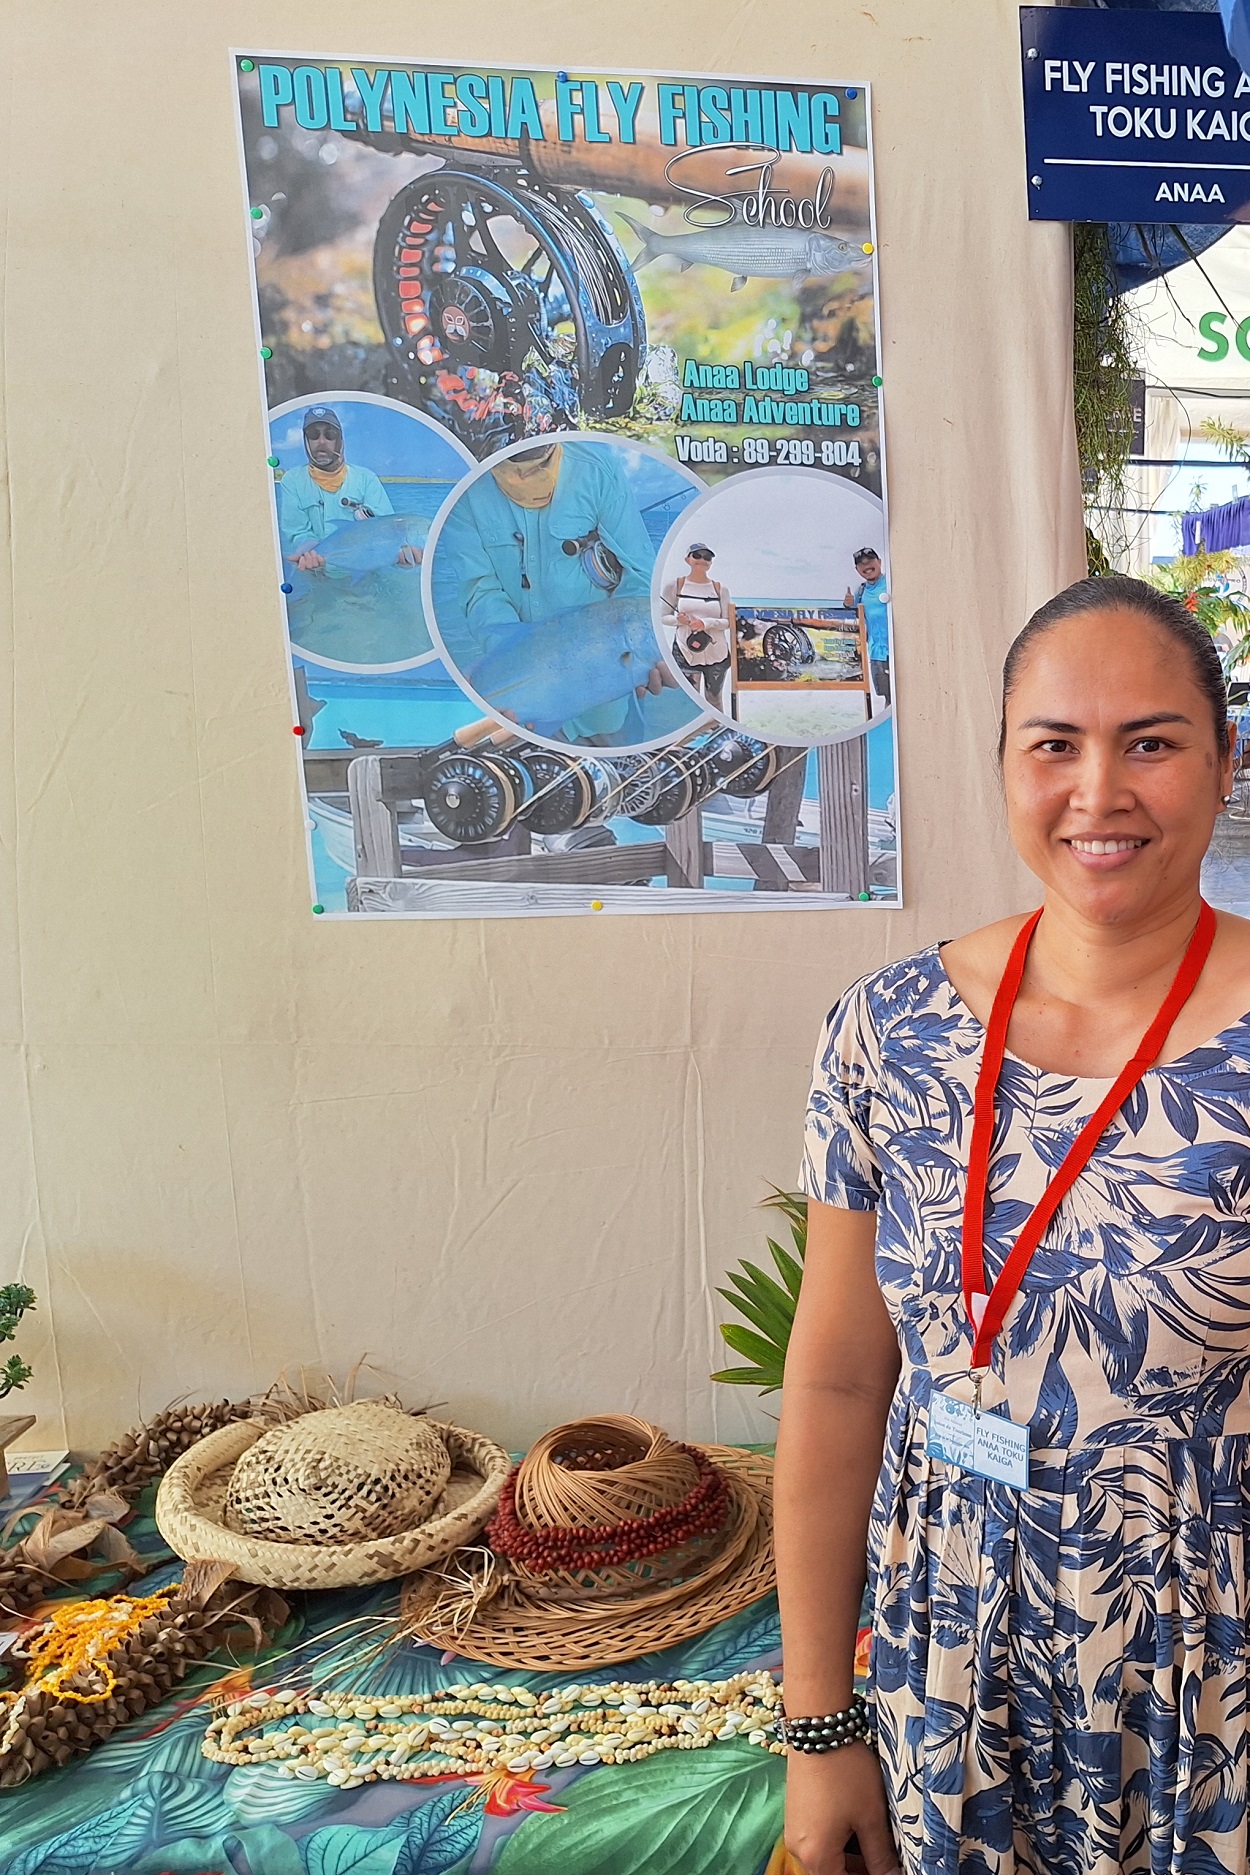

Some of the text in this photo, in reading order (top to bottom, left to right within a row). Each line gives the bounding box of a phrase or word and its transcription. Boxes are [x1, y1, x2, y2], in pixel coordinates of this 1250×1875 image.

[1044, 59, 1096, 93] FLY
[1105, 62, 1226, 98] FISHING
[258, 64, 842, 155] POLYNESIA FLY FISHING
[1090, 106, 1178, 139] TOKU
[663, 142, 835, 230] School
[1154, 183, 1226, 203] ANAA
[684, 359, 809, 395] Anaa Lodge
[681, 393, 861, 427] Anaa Adventure
[675, 435, 727, 463] Voda
[743, 438, 862, 466] 89-299-804
[976, 1426, 990, 1439] FLY
[991, 1432, 1026, 1453] FISHING
[977, 1438, 999, 1452] ANAA
[1001, 1446, 1024, 1462] TOKU
[987, 1451, 1013, 1468] KAIGA
